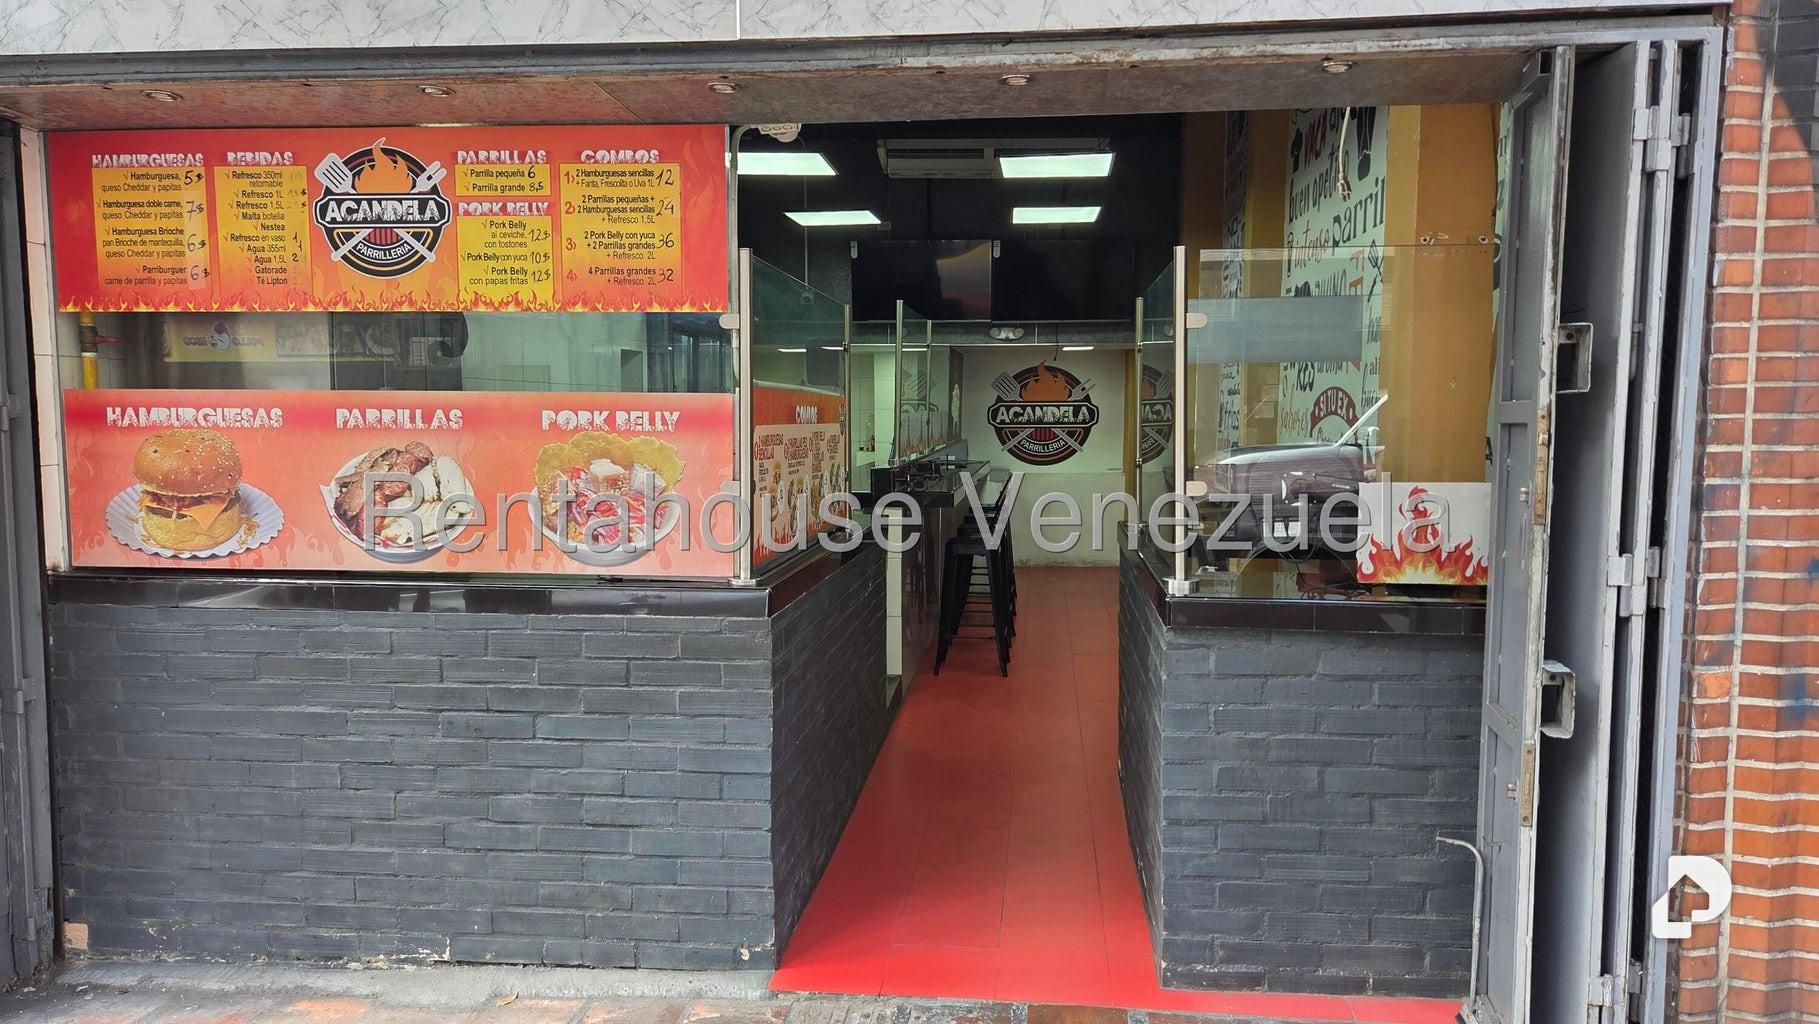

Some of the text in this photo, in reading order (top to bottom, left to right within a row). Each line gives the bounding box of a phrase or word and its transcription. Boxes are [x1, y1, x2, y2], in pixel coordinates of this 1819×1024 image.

[92, 153, 204, 168] HAMBURGUESAS
[226, 151, 294, 166] BEBIDAS
[457, 150, 547, 165] PARRILLAS
[580, 149, 659, 164] COMBOS
[131, 172, 181, 182] Hamburguesa,
[232, 170, 262, 180] Refresco
[263, 171, 283, 179] 350ml
[470, 169, 525, 179] Parrilla pequeña
[528, 165, 536, 179] 6
[576, 169, 654, 179] 2 Hamburguesas sencillas
[656, 169, 674, 186] 12
[102, 182, 182, 193] queso Cheddar y papitas
[249, 180, 283, 188] retornable
[472, 183, 525, 193] Parrilla grande
[581, 179, 599, 188] Fanta,
[600, 179, 628, 188] Frescolita
[634, 179, 646, 187] Uva
[242, 190, 273, 199] Refresco
[582, 195, 586, 203] 2
[588, 195, 615, 203] Parrillas
[616, 195, 649, 204] pequeñas
[103, 200, 144, 210] Hamburguesa
[146, 200, 163, 208] doble
[236, 200, 268, 210] Refresco
[458, 202, 549, 216] PORK BELLY
[583, 205, 628, 215] Hamburguesas
[629, 205, 655, 213] sencillas
[324, 200, 440, 221] ACANDELA
[102, 211, 183, 221] queso Cheddar y papitas
[242, 212, 284, 220] Malta botella
[608, 215, 638, 224] Refresco
[261, 223, 285, 231] Nestea
[490, 220, 527, 231] Pork Belly
[112, 227, 184, 237] Hamburguesa Brioche
[491, 230, 497, 239] al
[584, 231, 588, 239] 2
[590, 231, 606, 239] Pork
[607, 231, 623, 241] Belly
[640, 233, 656, 241] yuca
[103, 240, 114, 248] pan
[116, 238, 138, 246] Brioche
[140, 238, 147, 246] de
[230, 234, 260, 242] Refresco
[247, 244, 286, 254] Agua 355ml
[498, 240, 527, 248] tostones
[598, 241, 626, 249] Parrillas
[628, 242, 656, 252] grandes
[105, 249, 186, 259] queso Cheddar y papitas
[356, 243, 412, 260] PARRILLERIA
[613, 251, 643, 260] Refresco
[647, 252, 656, 260] 2L
[254, 255, 271, 265] Agua
[466, 253, 484, 261] Pork
[484, 253, 500, 263] Belly
[513, 254, 528, 263] yuca
[142, 265, 187, 275] Parriburguer
[255, 266, 287, 274] Gatorade
[491, 267, 528, 277] Pork Belly
[595, 267, 624, 275] Parrillas
[626, 267, 656, 277] grandes
[105, 276, 187, 286] carne de parrilla y papitas
[266, 277, 288, 286] Lipton
[485, 278, 508, 286] papas
[510, 277, 528, 285] fritas
[614, 277, 644, 286] Refresco
[648, 277, 656, 285] 2L
[106, 406, 283, 428] HAMBURGUESAS
[335, 408, 464, 429] PARRILLAS
[996, 406, 1090, 422] ACANDELA
[541, 410, 680, 432] PORK BELLY
[1020, 439, 1066, 452] PARRILLERIA
